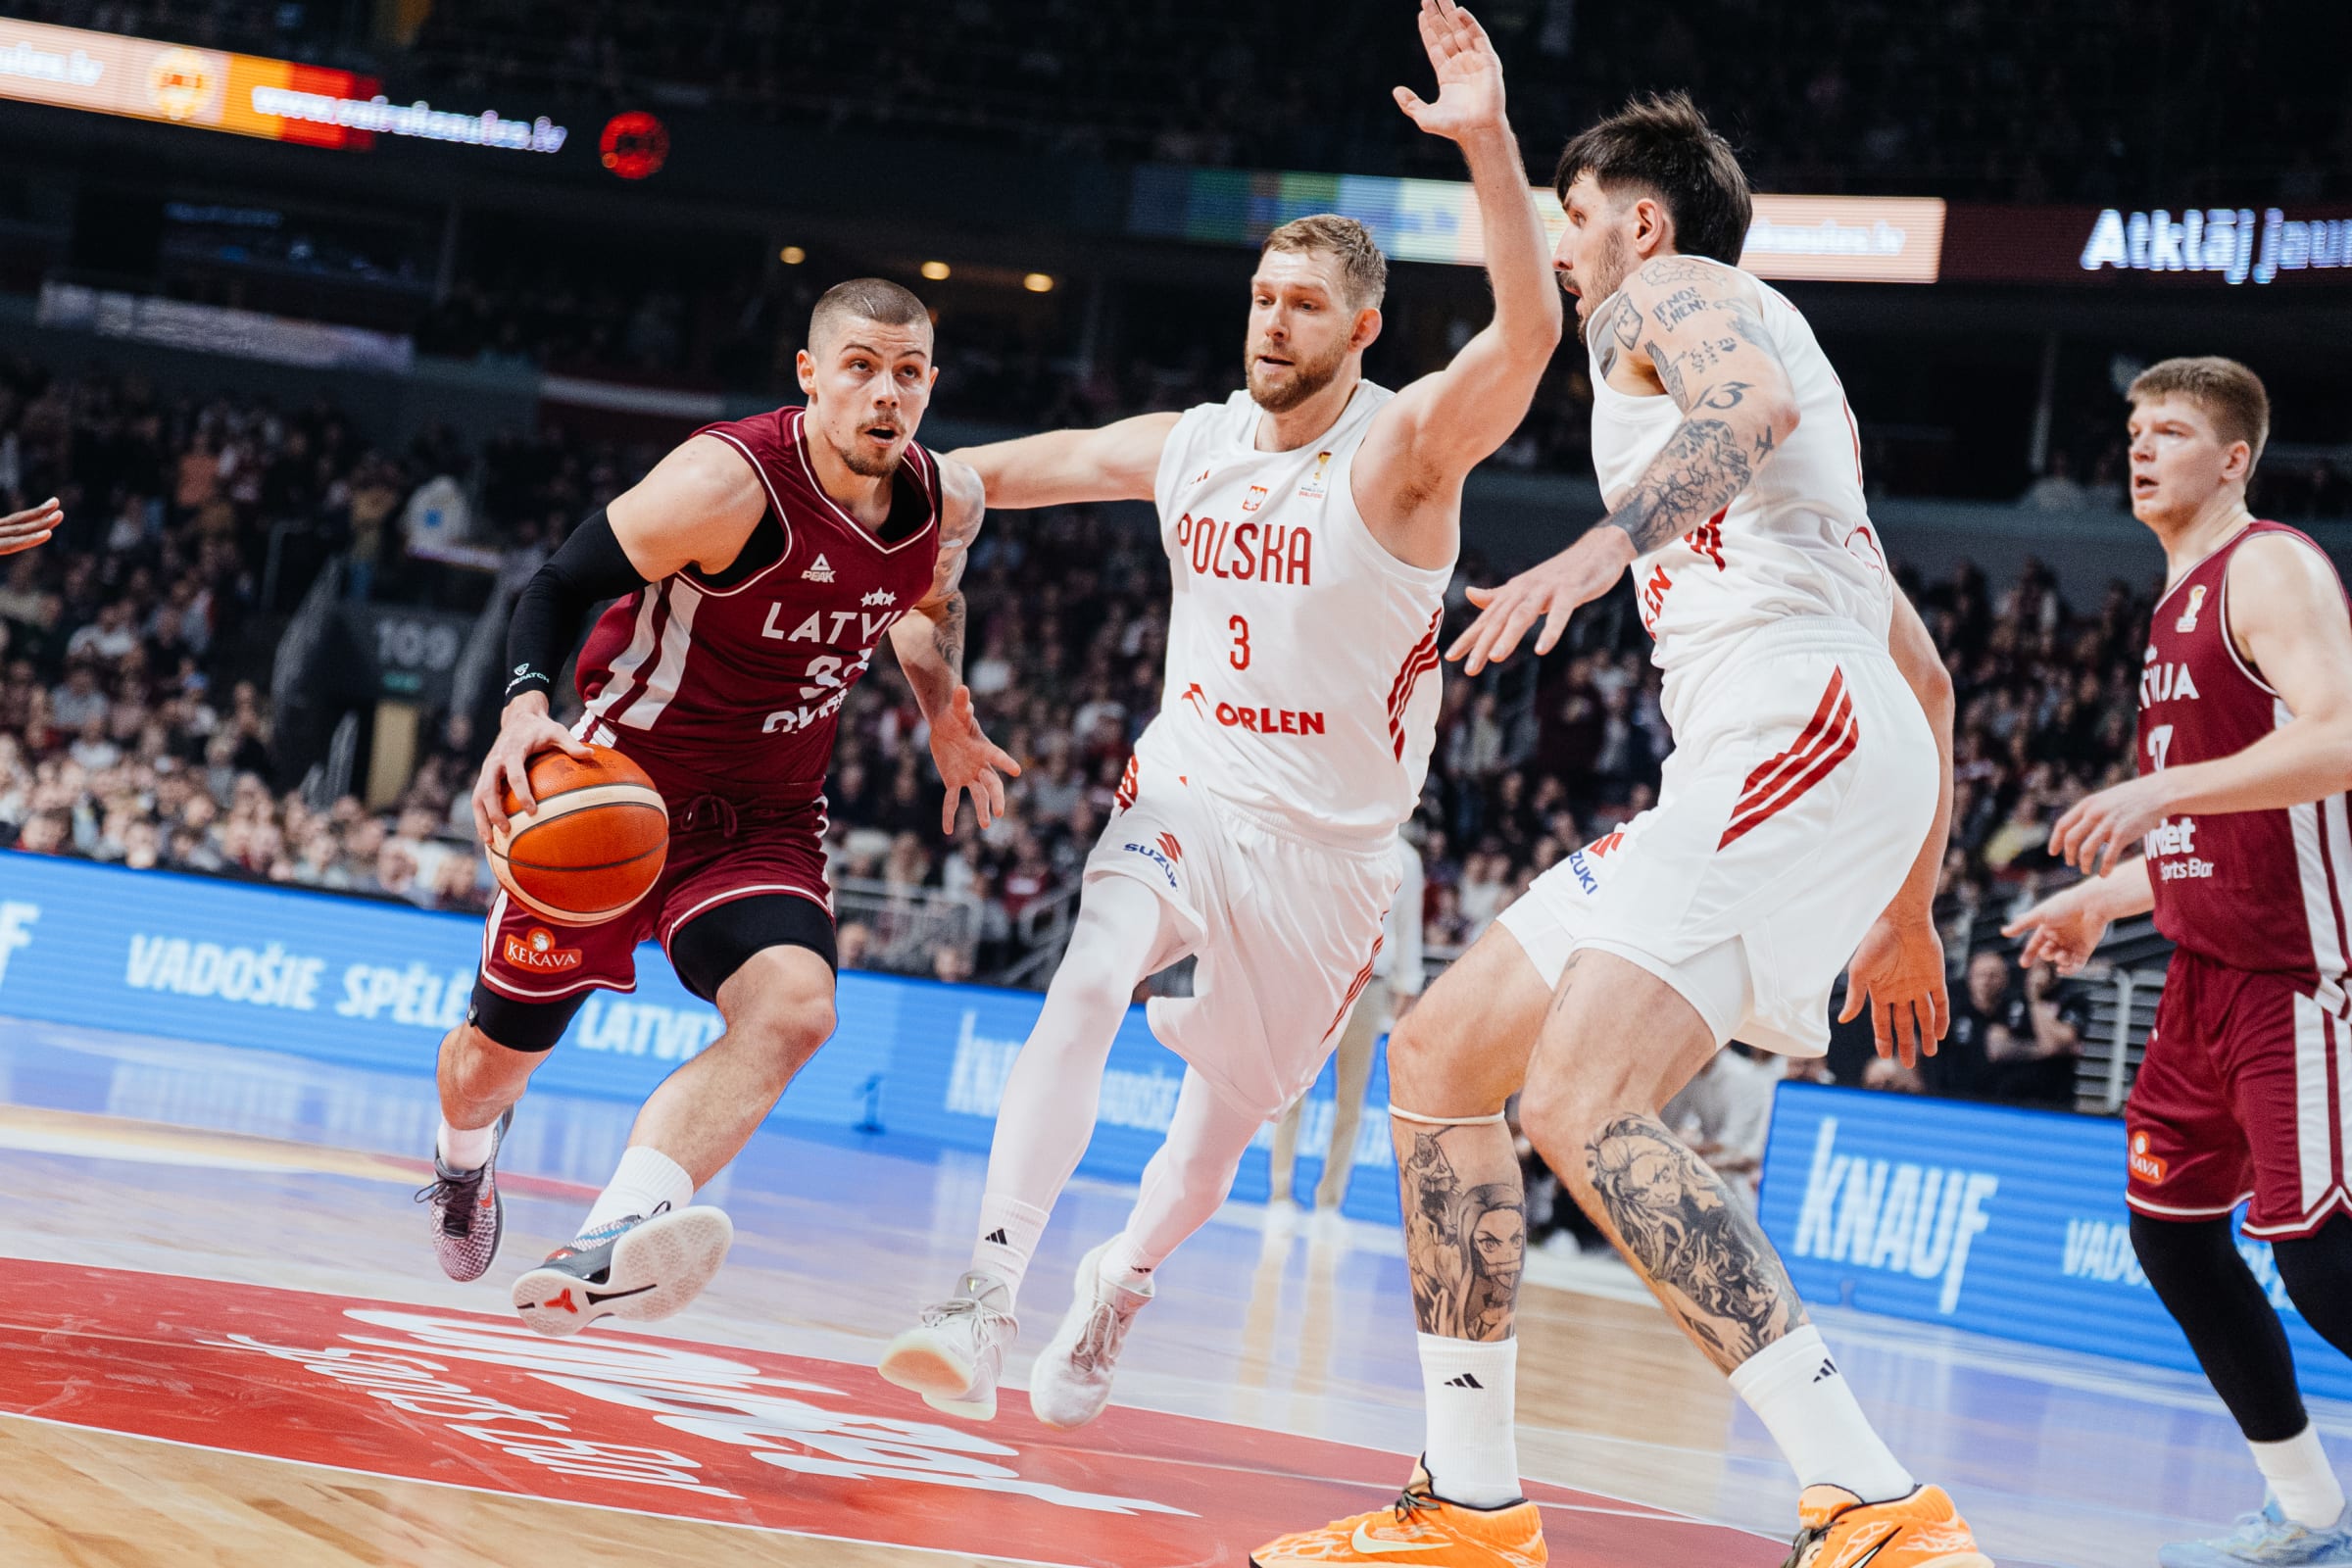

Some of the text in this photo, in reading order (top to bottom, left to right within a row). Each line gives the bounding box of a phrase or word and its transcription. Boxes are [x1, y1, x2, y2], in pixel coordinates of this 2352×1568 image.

[2080, 209, 2256, 284] Atklāj
[1177, 512, 1312, 586] POLSKA
[801, 570, 836, 583] PEAK
[761, 602, 903, 645] LATVI
[1229, 614, 1250, 670] 3
[1215, 702, 1326, 735] ORLEN
[2147, 723, 2174, 771] 7
[1123, 843, 1178, 892] SUZUK
[1569, 851, 1598, 896] ZUKI
[2187, 857, 2215, 878] Bar
[126, 933, 326, 1012] VADOŠIE
[508, 941, 578, 967] ĶEKAVA
